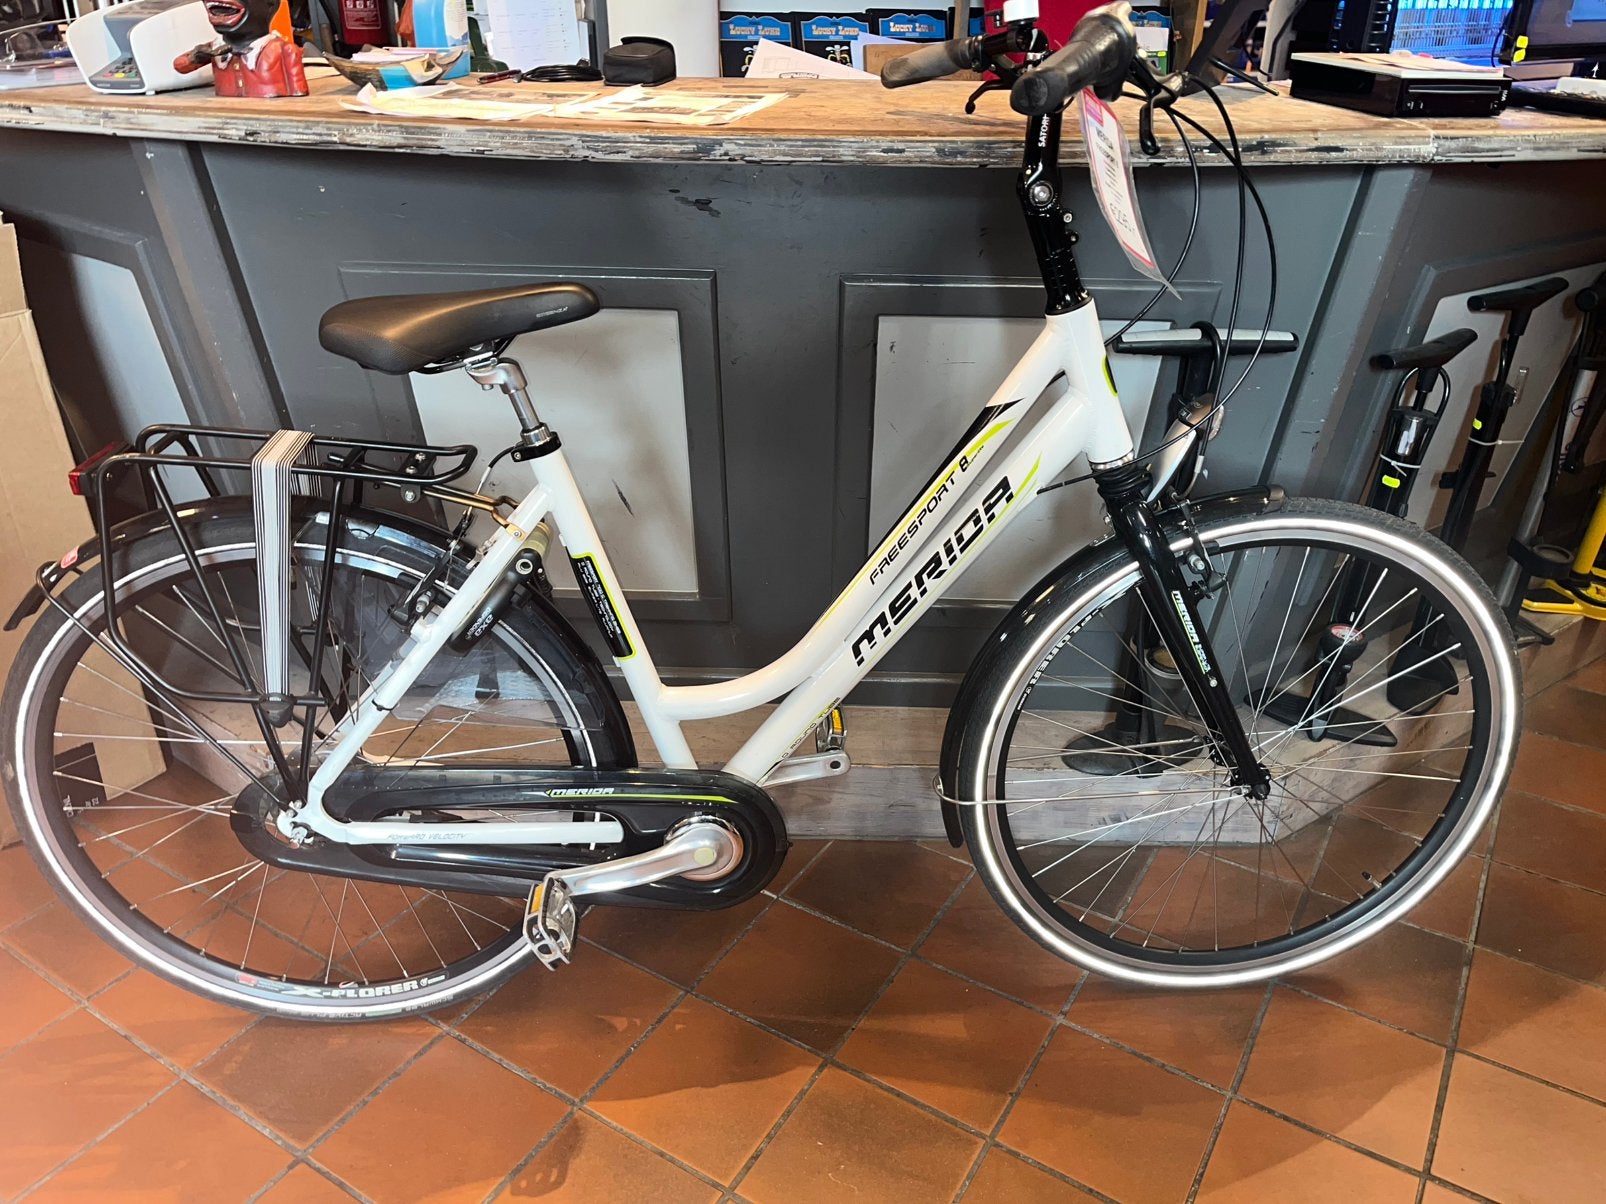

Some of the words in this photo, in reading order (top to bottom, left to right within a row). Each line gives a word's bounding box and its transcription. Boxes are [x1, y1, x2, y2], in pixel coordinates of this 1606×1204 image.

[869, 470, 956, 586] FREESPORT
[958, 455, 969, 473] 8
[851, 475, 1015, 667] MERIDA
[1171, 590, 1200, 643] MERIDA
[550, 787, 615, 797] MERIDA
[280, 979, 419, 998] X-PLORER
